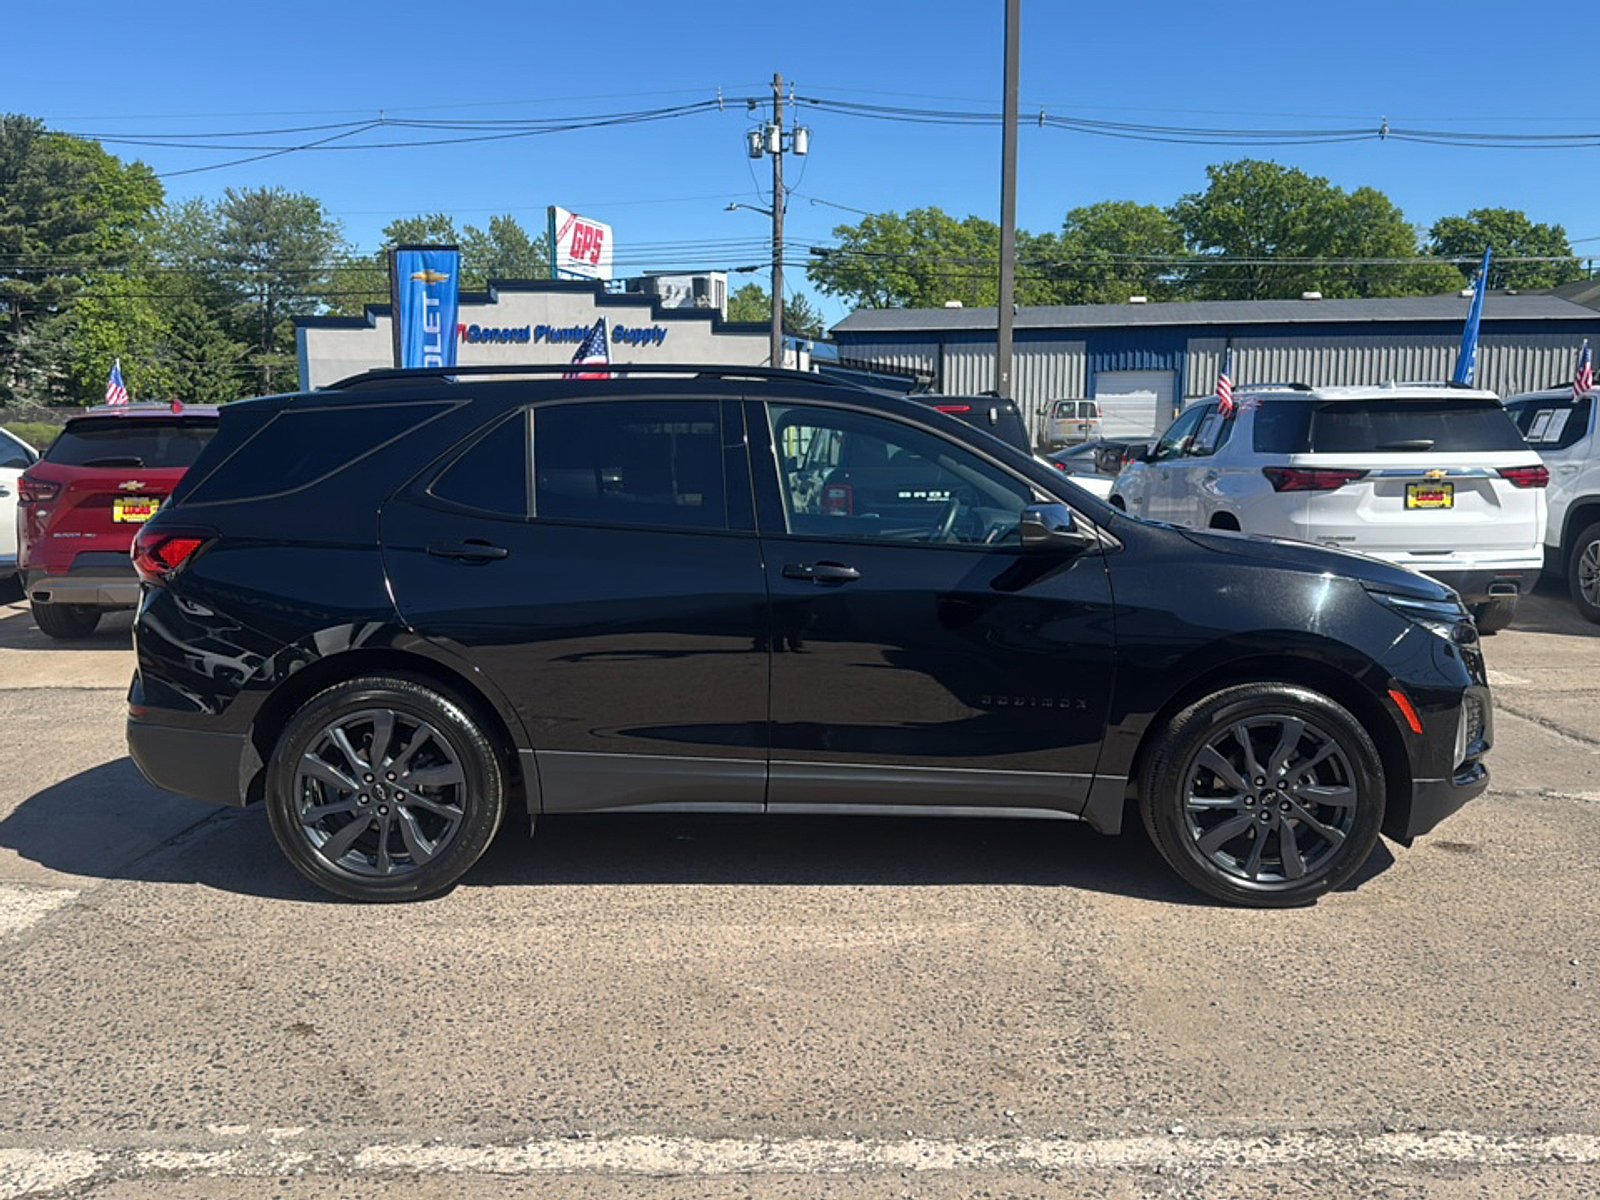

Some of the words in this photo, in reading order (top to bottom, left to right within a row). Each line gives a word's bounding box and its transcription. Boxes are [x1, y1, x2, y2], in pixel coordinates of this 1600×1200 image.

[569, 222, 604, 264] GPS
[467, 325, 530, 344] General
[611, 325, 667, 347] Supply
